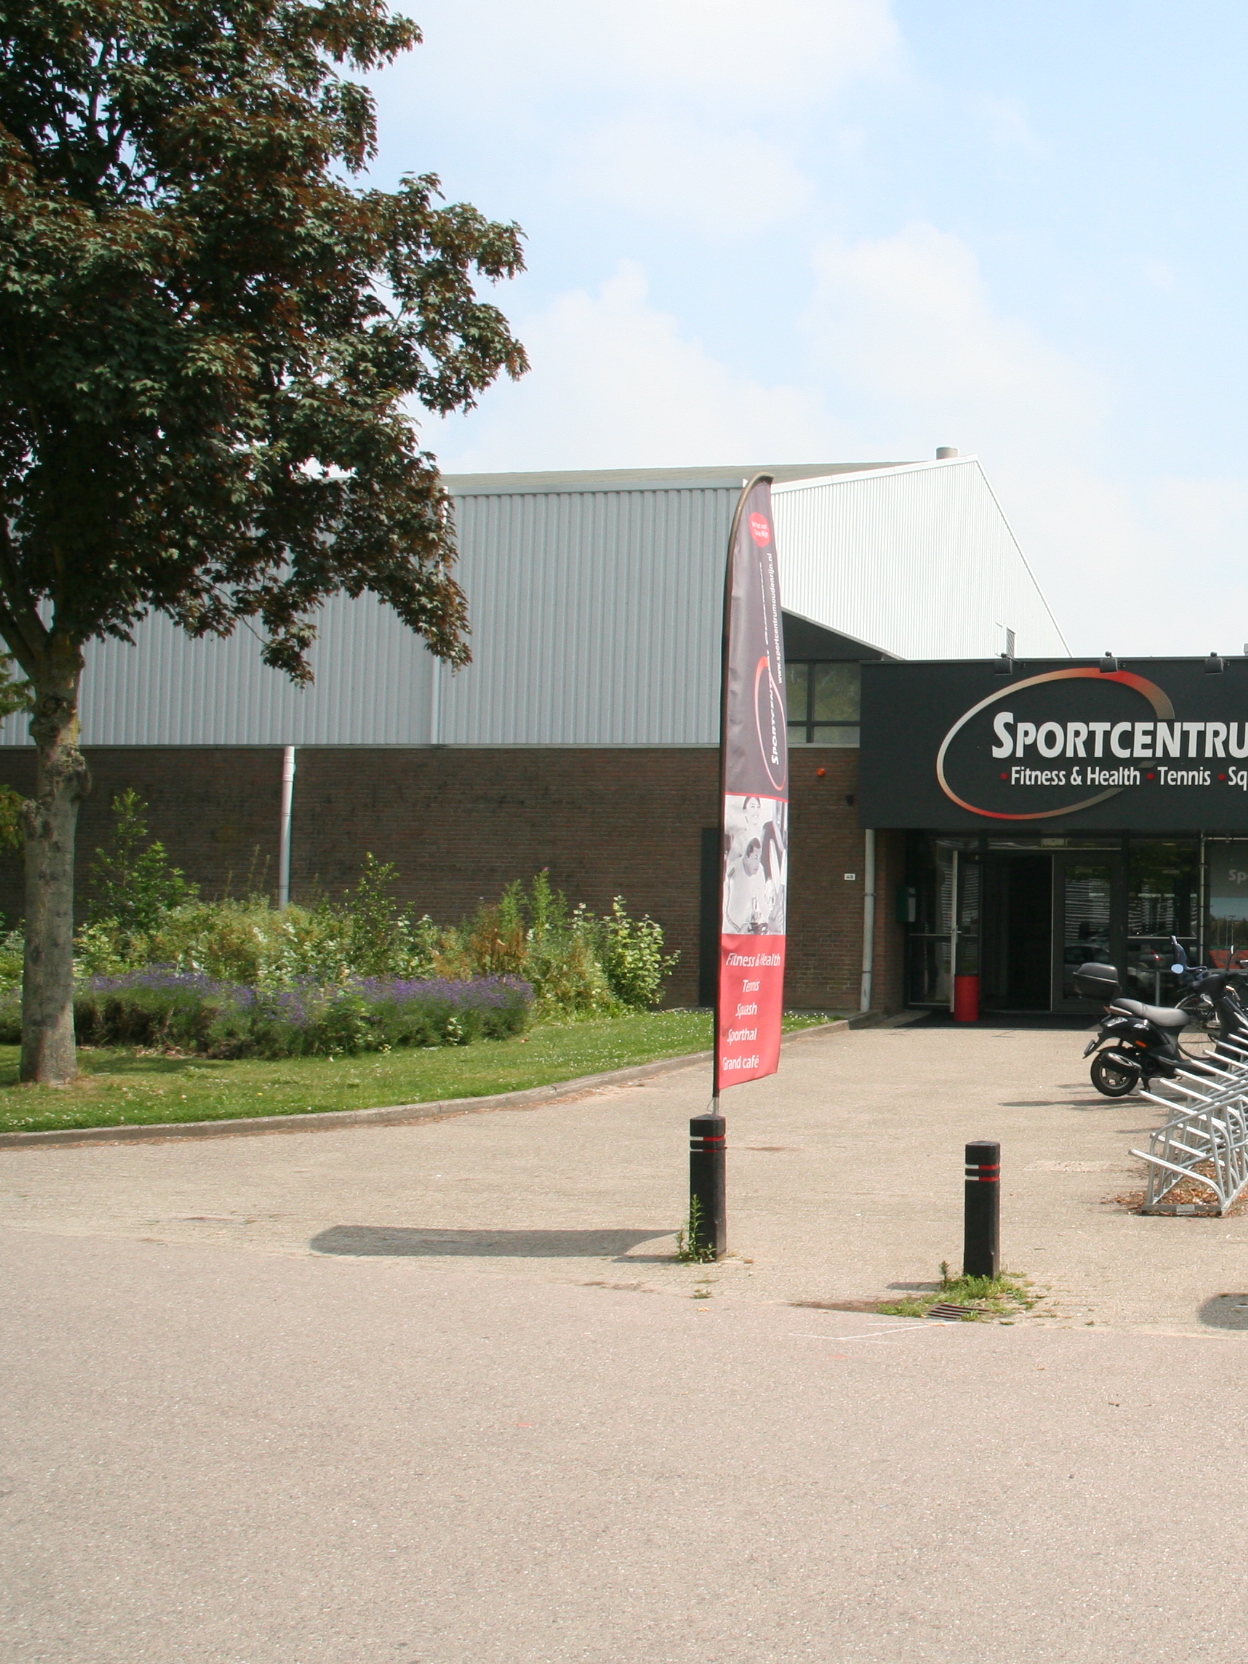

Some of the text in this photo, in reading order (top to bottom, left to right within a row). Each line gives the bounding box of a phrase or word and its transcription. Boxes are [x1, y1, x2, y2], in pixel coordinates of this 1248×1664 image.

[1011, 766, 1066, 786] Fitness
[1070, 767, 1083, 786] &
[1086, 766, 1141, 786] Health
[1157, 766, 1211, 786] Tennis
[725, 952, 755, 968] Fitness
[726, 1027, 758, 1046] Sporthal
[722, 1054, 760, 1071] Grand café
